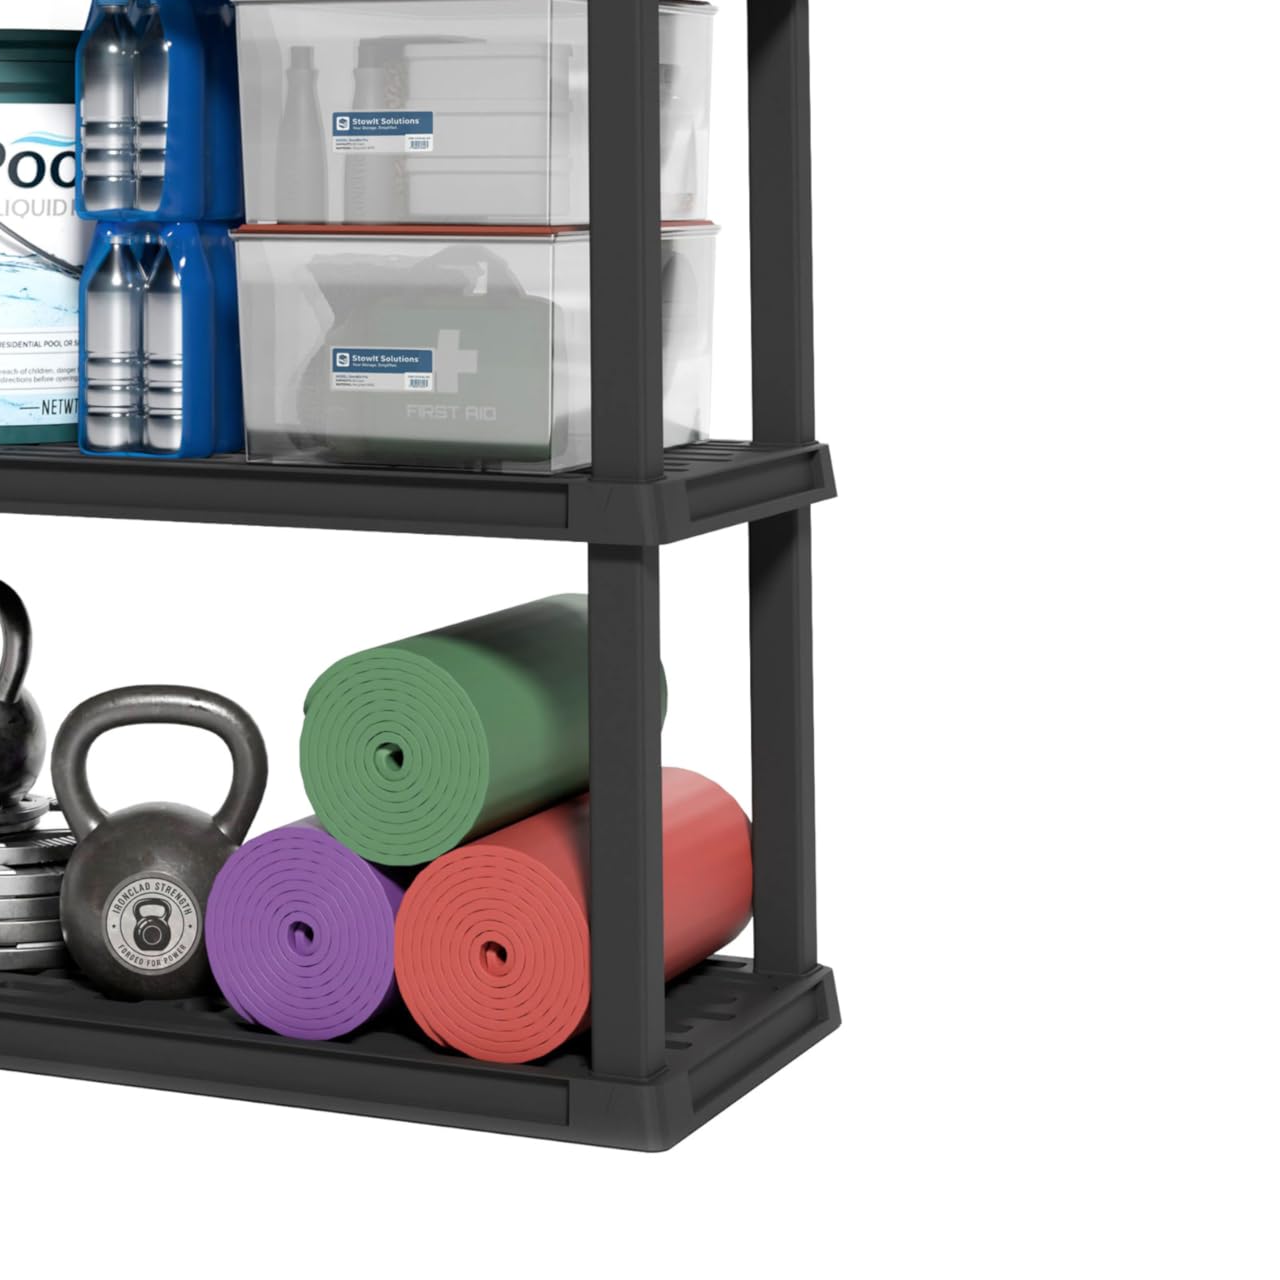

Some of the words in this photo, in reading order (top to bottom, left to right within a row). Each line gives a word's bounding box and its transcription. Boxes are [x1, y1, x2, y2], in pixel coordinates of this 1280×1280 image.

[381, 117, 420, 125] Solutions
[44, 340, 62, 348] POOL
[381, 355, 419, 363] Solutions
[0, 375, 31, 383] directions
[407, 404, 460, 420] FIRST
[465, 406, 496, 420] AID
[112, 882, 151, 914] IRONCLAD
[154, 882, 193, 915] STRENGTH
[118, 944, 144, 965] FORGED
[146, 959, 161, 967] FOR
[163, 944, 187, 965] POWER
